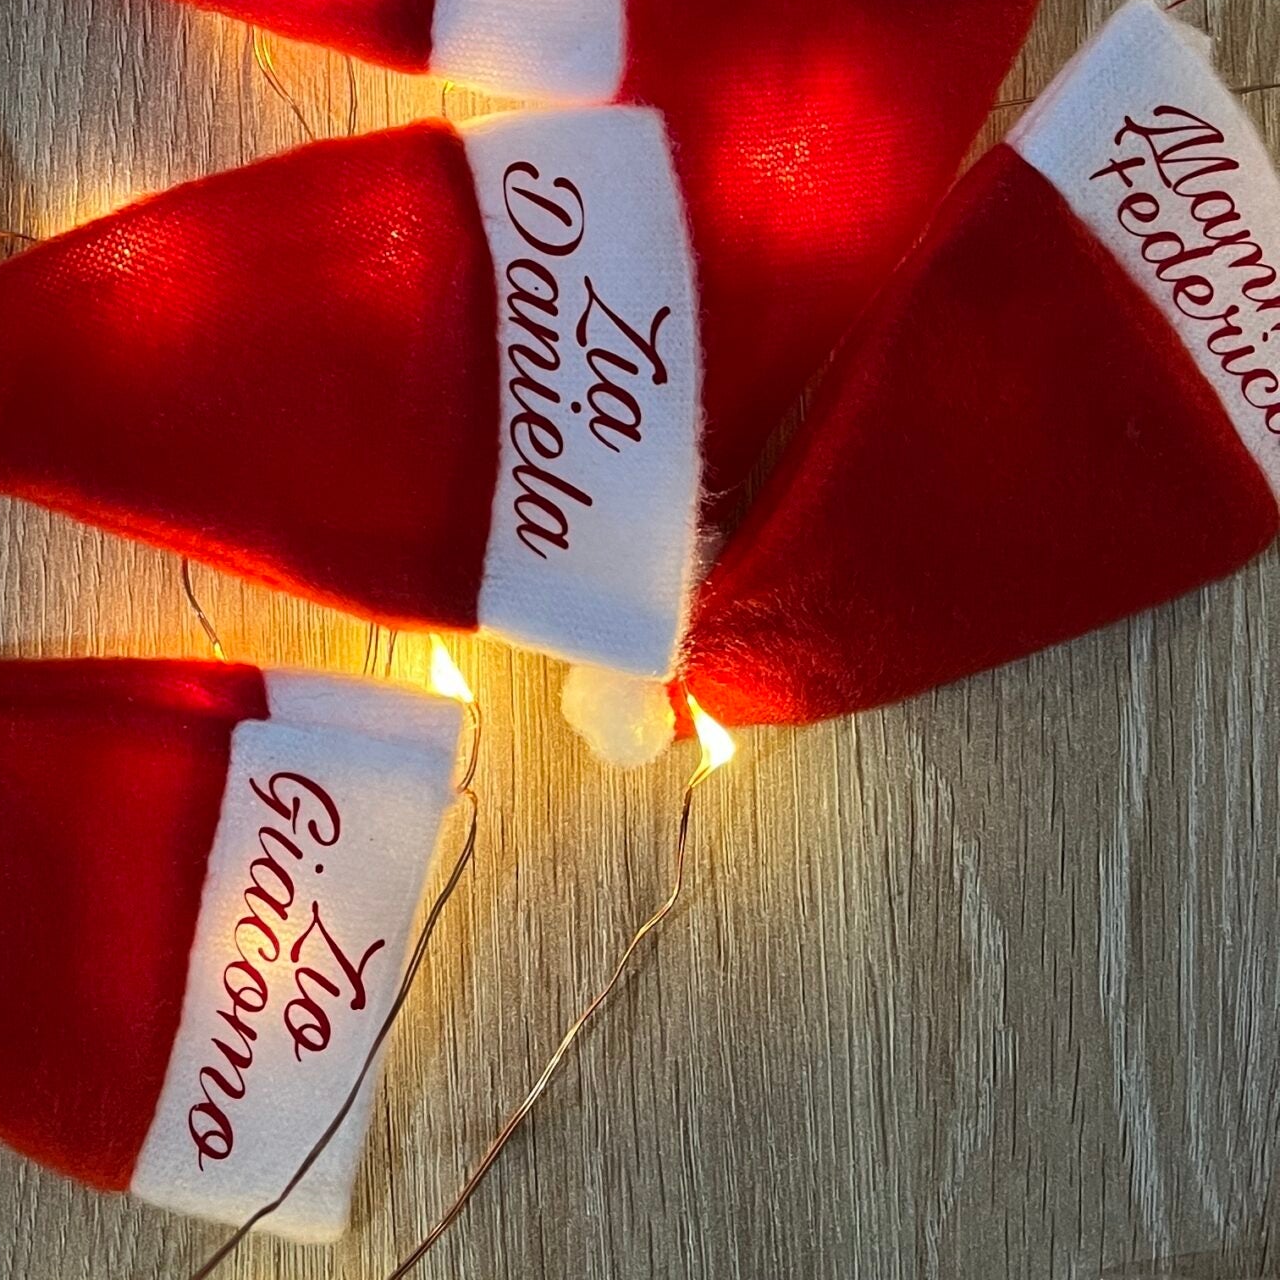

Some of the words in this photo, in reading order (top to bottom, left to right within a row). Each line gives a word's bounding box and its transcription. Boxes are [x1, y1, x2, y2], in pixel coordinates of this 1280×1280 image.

[1135, 105, 1280, 332] Mam
[502, 160, 593, 560] Daniela
[575, 275, 671, 454] Zia
[187, 770, 341, 1172] Giacomo
[282, 900, 386, 1063] Zio
